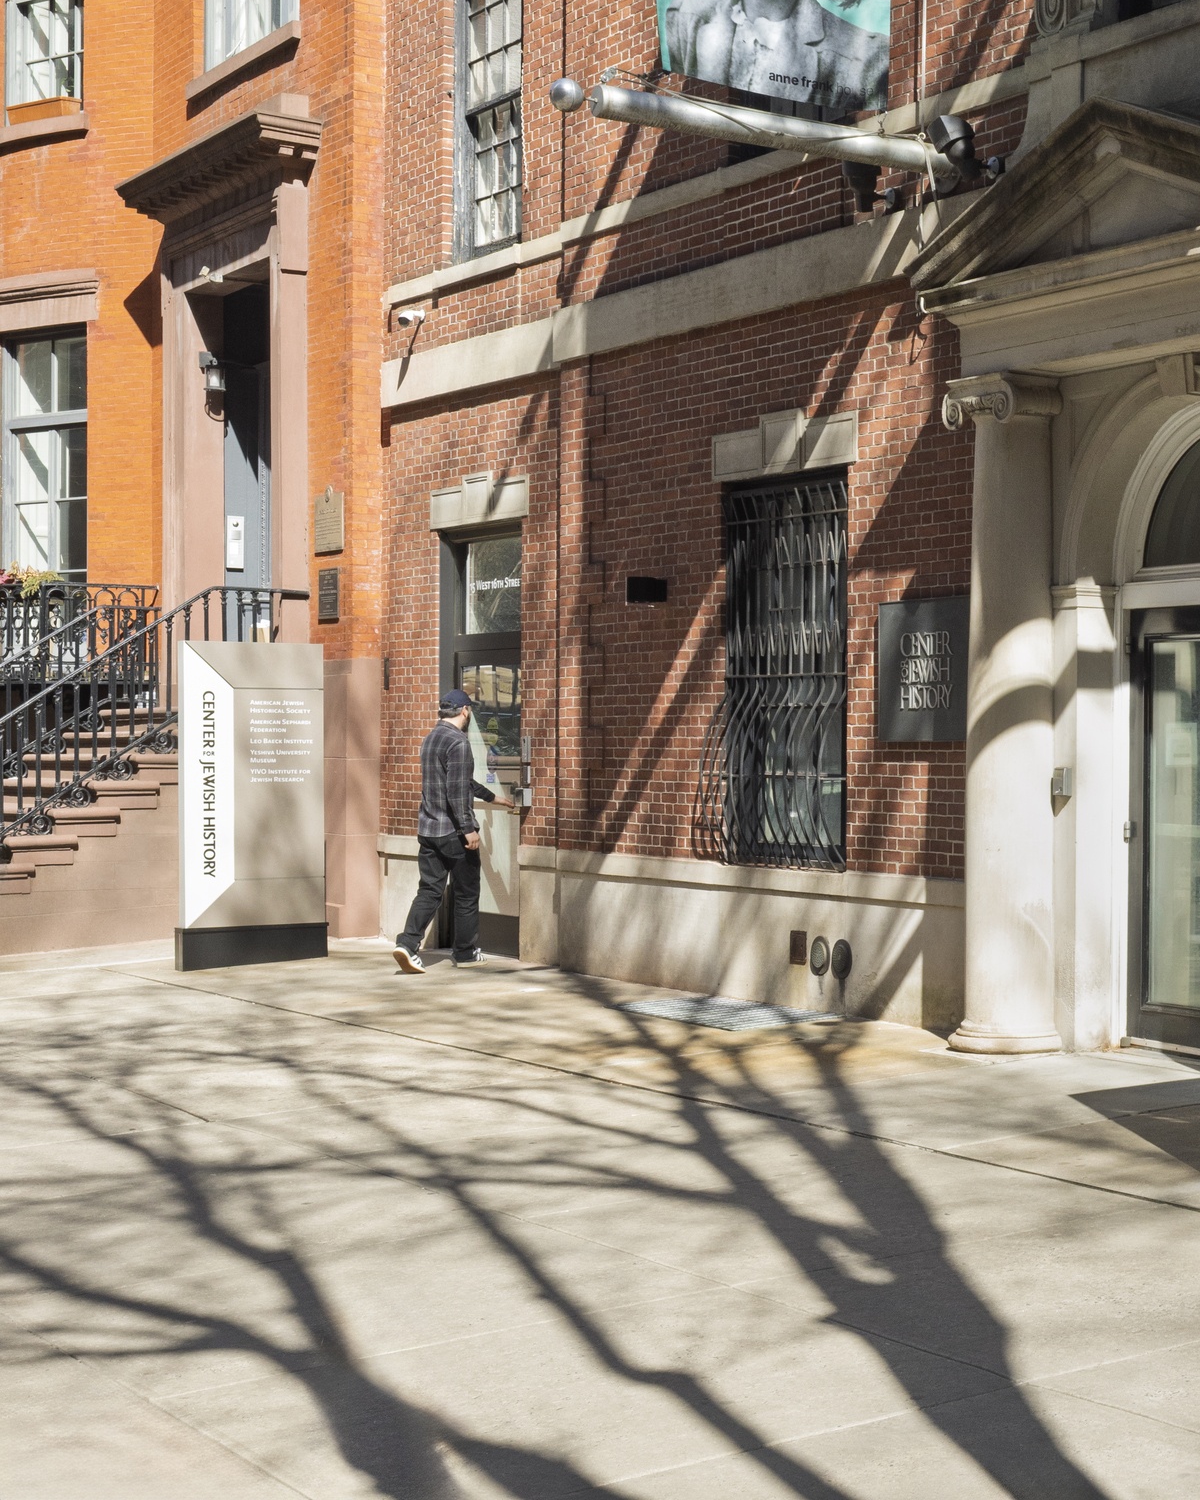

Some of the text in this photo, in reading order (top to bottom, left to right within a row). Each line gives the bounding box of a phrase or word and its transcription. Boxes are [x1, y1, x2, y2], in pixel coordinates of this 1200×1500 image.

[768, 72, 799, 86] anne
[801, 76, 833, 92] frank
[504, 577, 521, 588] STREE
[900, 630, 953, 657] CENTER
[900, 658, 909, 684] FOR
[907, 657, 950, 684] JEWISH
[900, 684, 953, 709] HISTORY
[203, 690, 215, 748] CENTER
[199, 759, 215, 811] JEWISH
[203, 817, 216, 877] HISTORY
